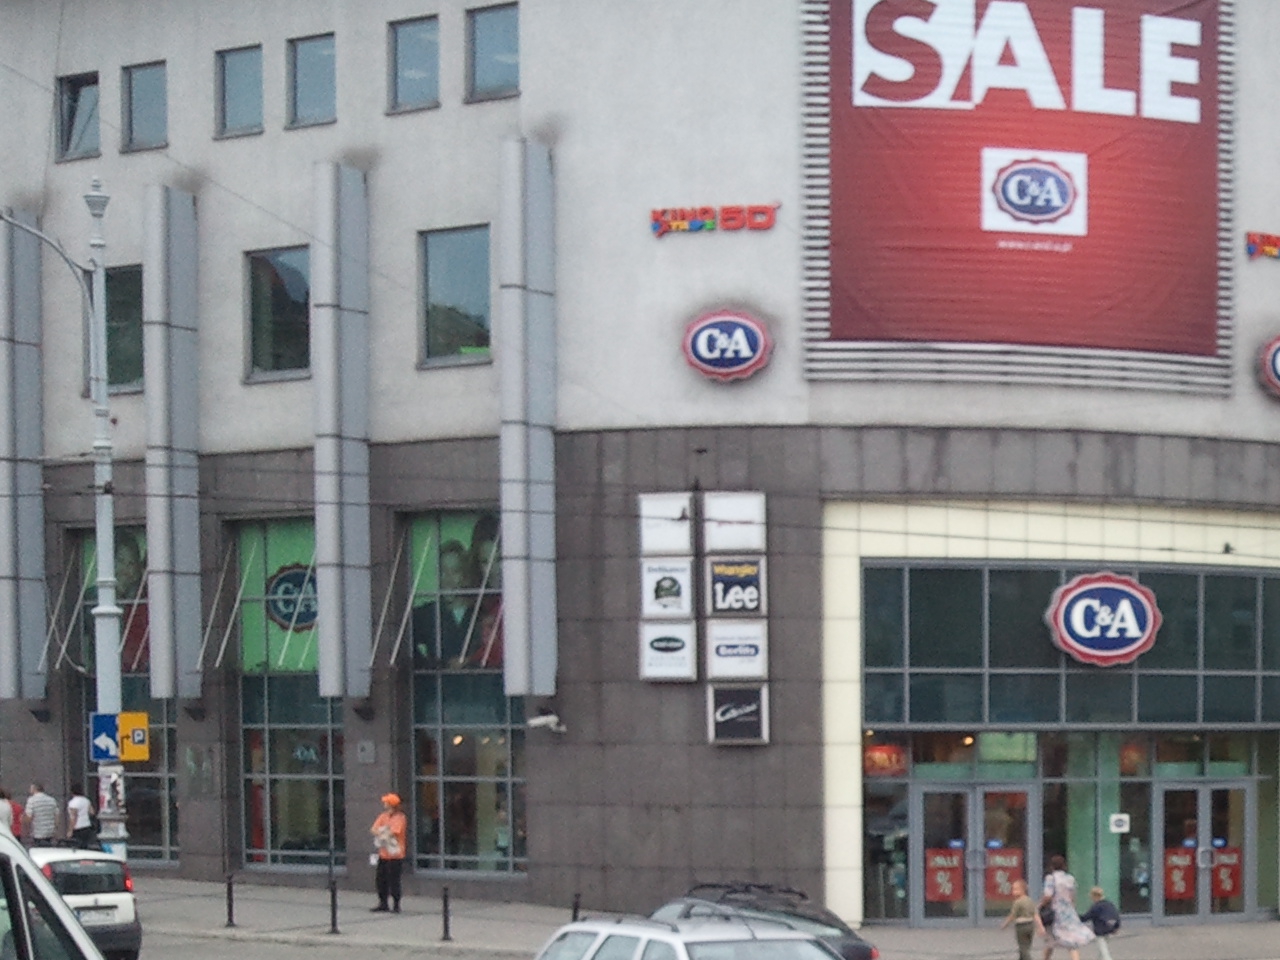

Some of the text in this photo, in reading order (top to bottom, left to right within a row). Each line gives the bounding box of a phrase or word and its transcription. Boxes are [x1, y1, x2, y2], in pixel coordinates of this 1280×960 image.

[857, 0, 1200, 124] SALE
[1007, 174, 1063, 208] C&A
[696, 327, 754, 360] C&A
[714, 582, 758, 610] Lee
[1070, 598, 1143, 639] C&A
